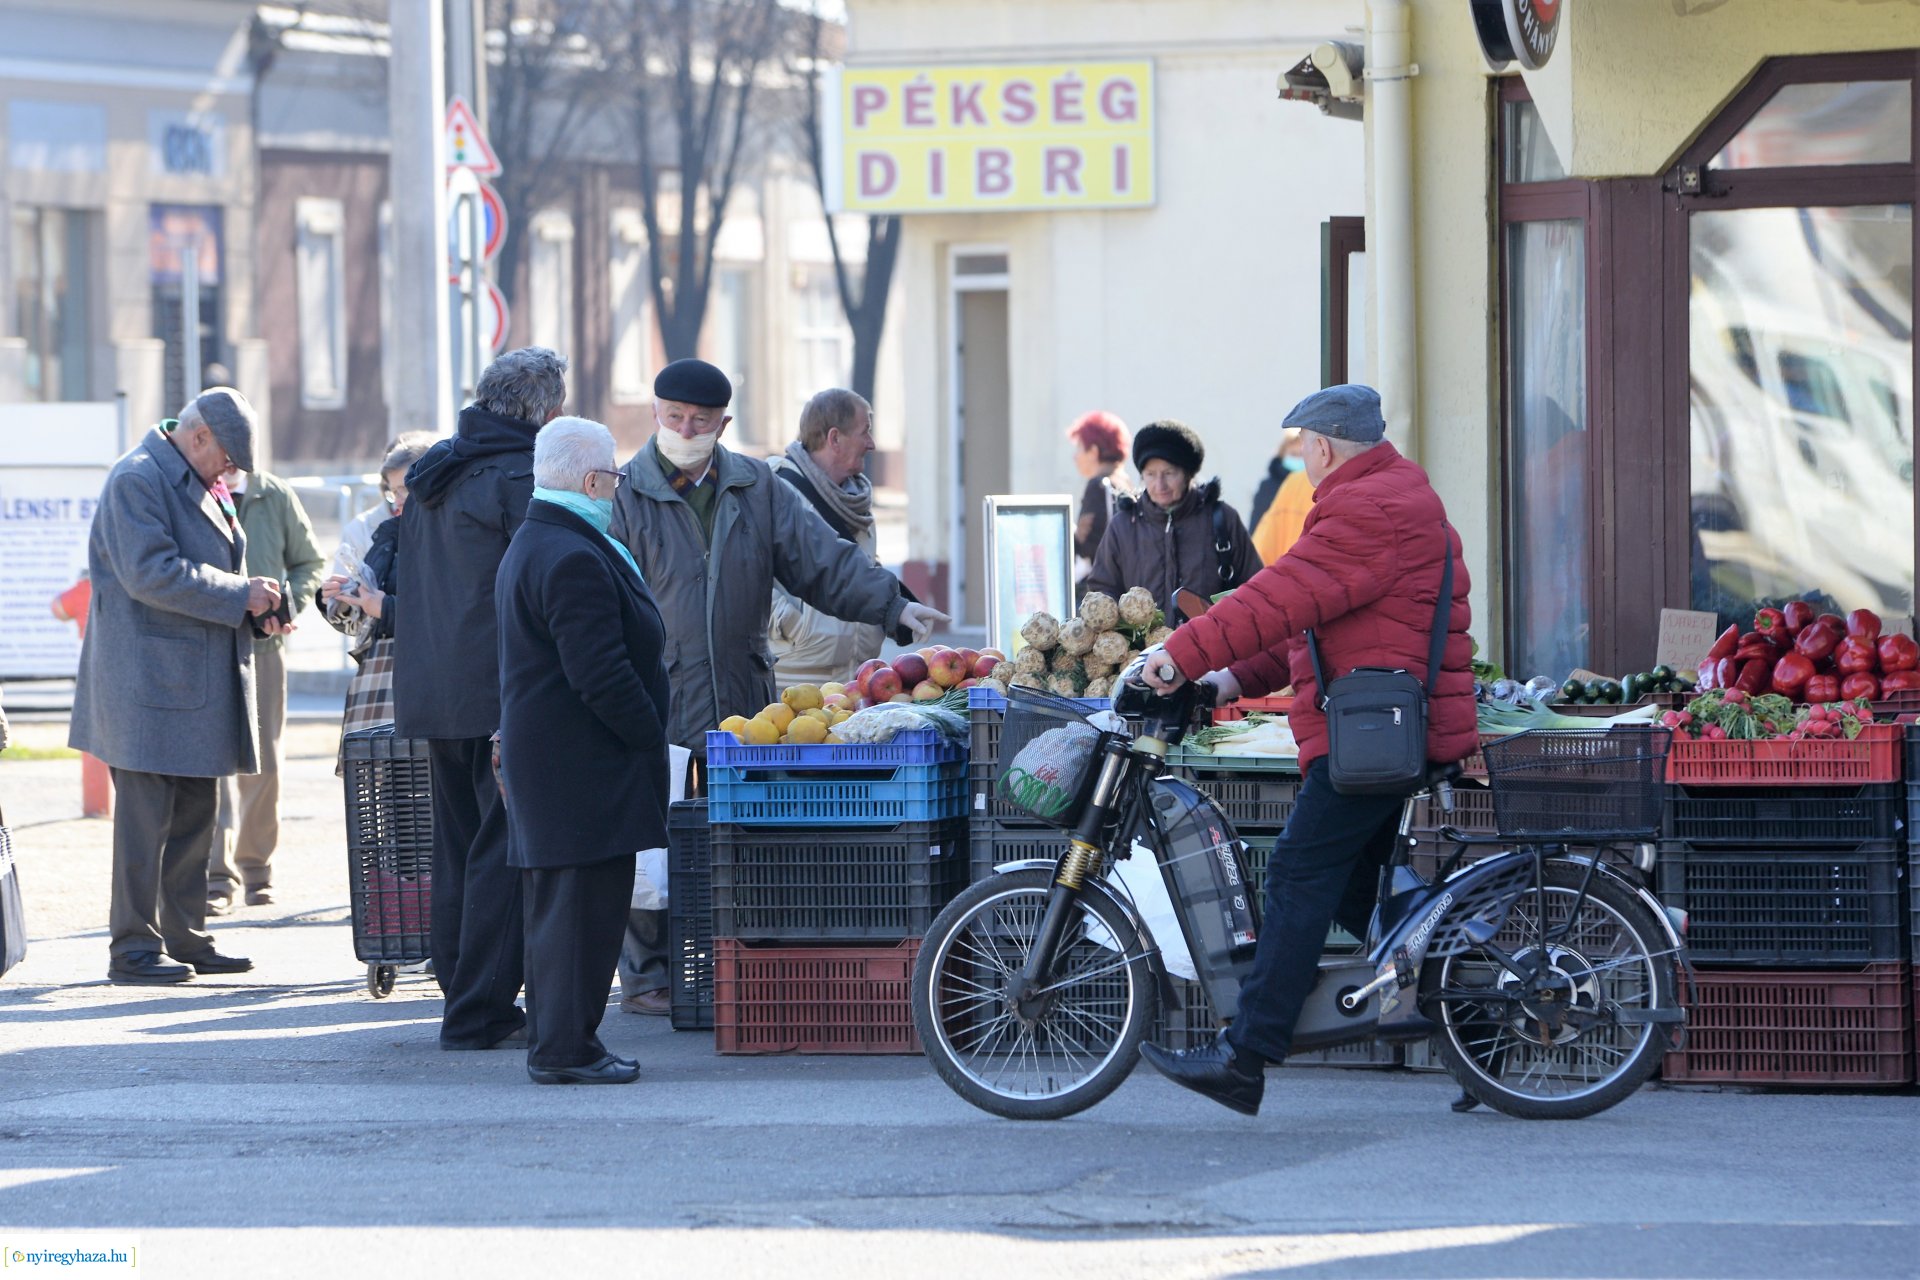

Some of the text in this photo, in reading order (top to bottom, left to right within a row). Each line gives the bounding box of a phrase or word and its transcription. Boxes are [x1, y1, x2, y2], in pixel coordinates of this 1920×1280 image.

[853, 71, 1139, 128] PÉKSÉG
[859, 146, 1128, 198] DIBRI
[0, 498, 100, 520] LENSIT B
